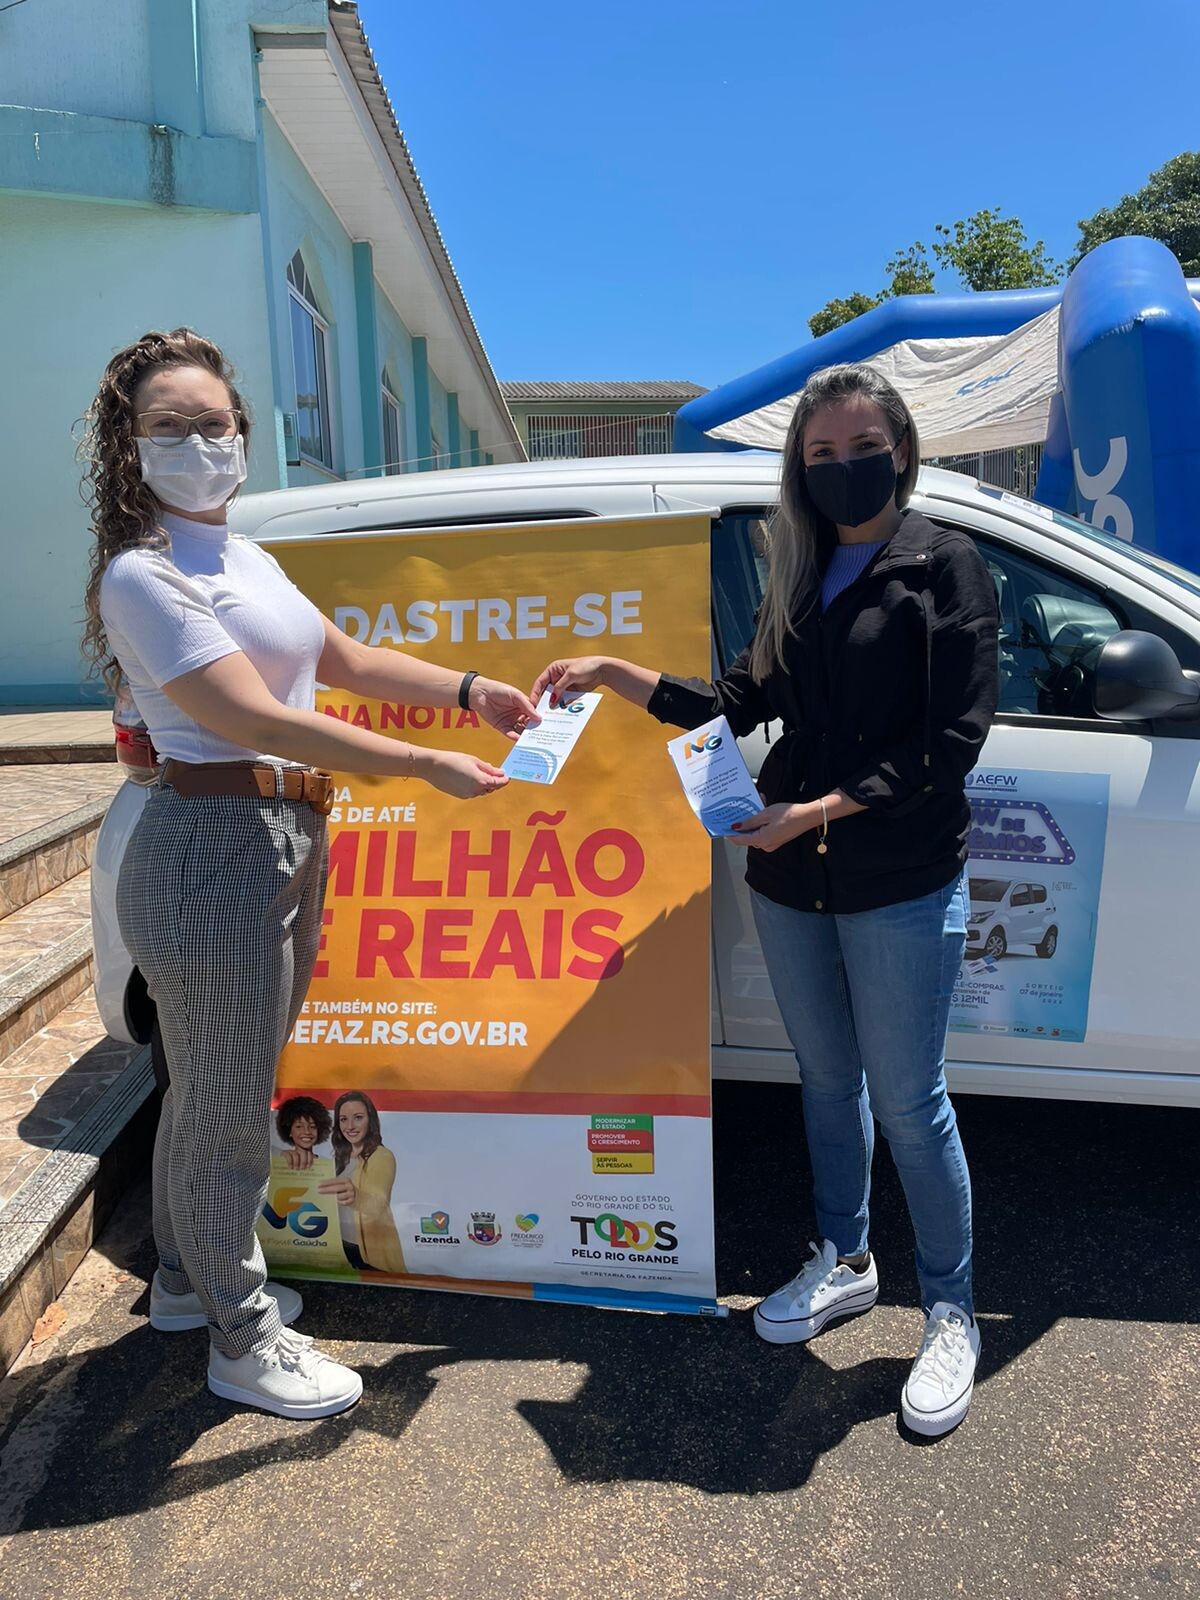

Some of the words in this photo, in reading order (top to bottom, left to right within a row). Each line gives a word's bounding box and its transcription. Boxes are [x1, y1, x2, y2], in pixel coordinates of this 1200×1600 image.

[334, 590, 643, 646] DASTRE-SE
[380, 702, 480, 729] NOTA
[976, 774, 1018, 786] AEFW
[347, 806, 375, 823] DE
[377, 801, 416, 823] ATÉ
[1001, 817, 1026, 833] DE
[355, 908, 625, 981] REAIS
[312, 998, 373, 1014] TAMBÉM
[376, 1002, 398, 1014] NO
[401, 1002, 438, 1015] SITE:
[961, 994, 989, 1004] 12MIL
[575, 1194, 618, 1202] GOVERNO
[620, 1195, 634, 1203] DO
[636, 1195, 671, 1203] ESTADO
[658, 1204, 674, 1212] SUL
[414, 1235, 460, 1244] Fazenda
[570, 1213, 678, 1252] TODOS
[572, 1249, 602, 1259] PELO
[605, 1251, 625, 1261] RIO
[628, 1253, 679, 1264] GRANDE
